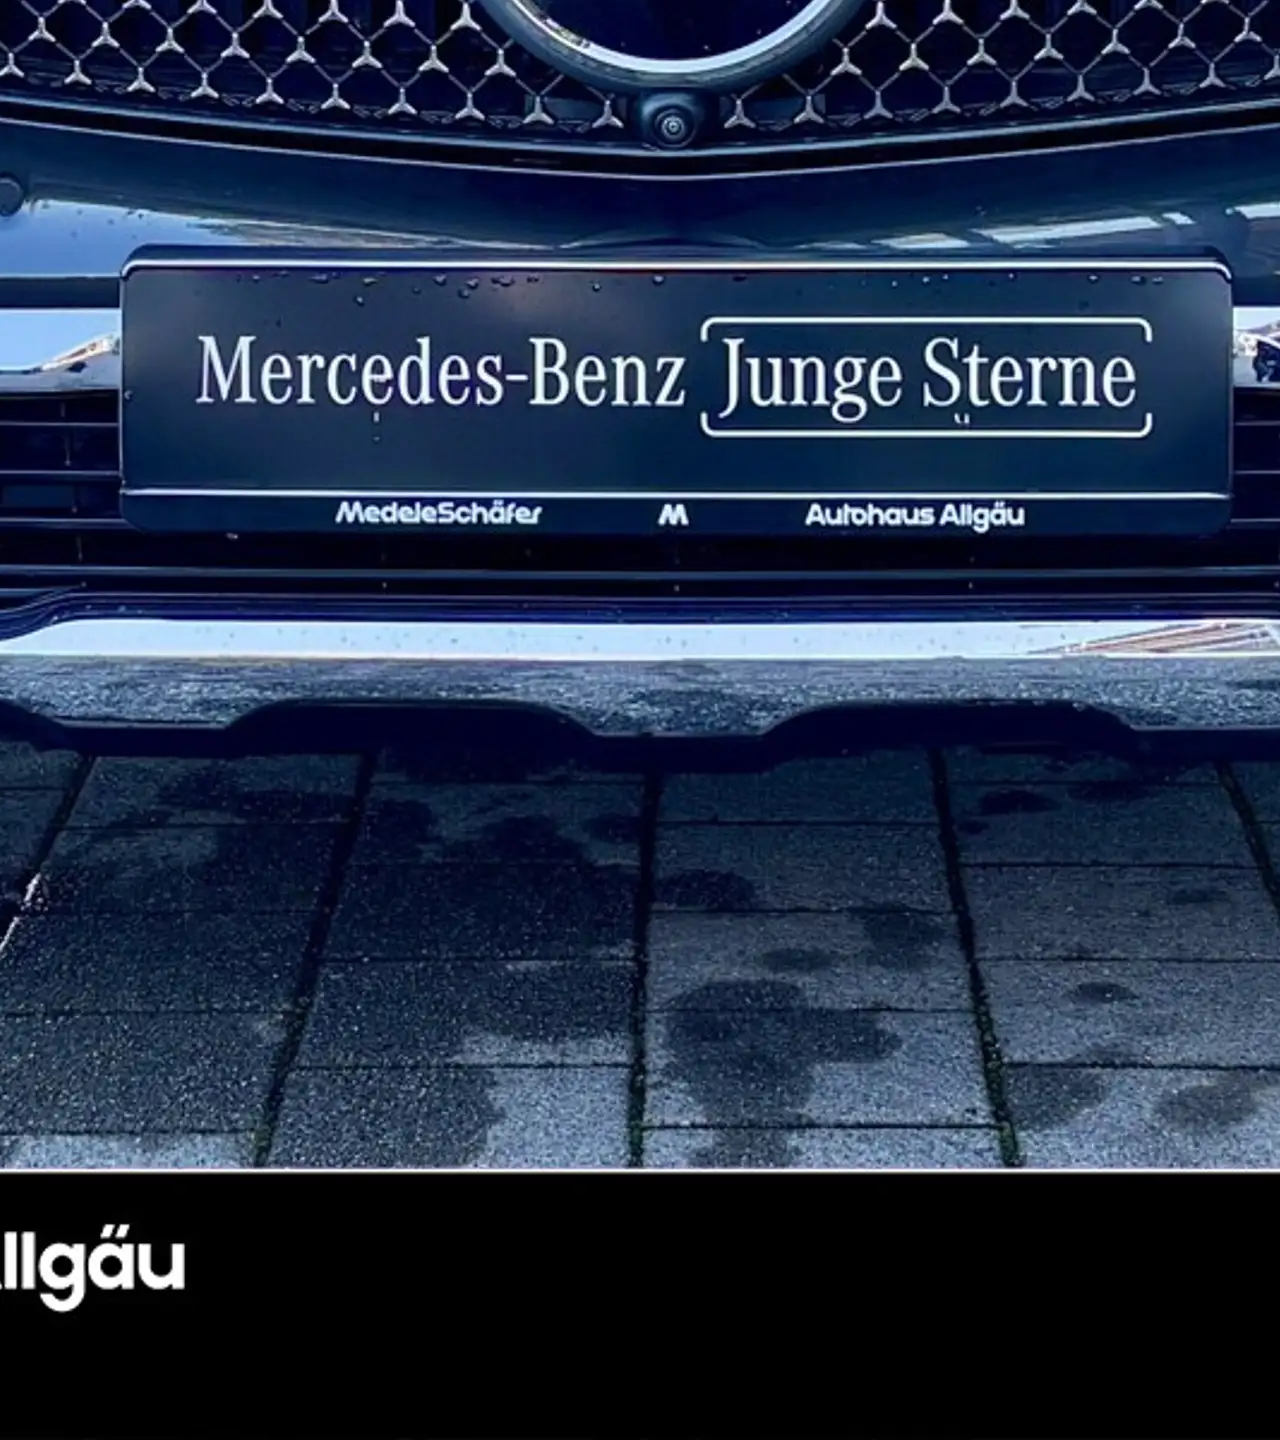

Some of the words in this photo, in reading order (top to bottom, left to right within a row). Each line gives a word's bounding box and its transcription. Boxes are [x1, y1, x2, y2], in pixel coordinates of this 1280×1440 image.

[195, 335, 686, 407] Mercedes-Benz
[718, 337, 903, 423] Junge
[923, 337, 1136, 408] Sterne
[335, 499, 543, 525] MedeleSchäfer
[805, 502, 936, 526] Autohaus
[938, 500, 1026, 534] Allgäu
